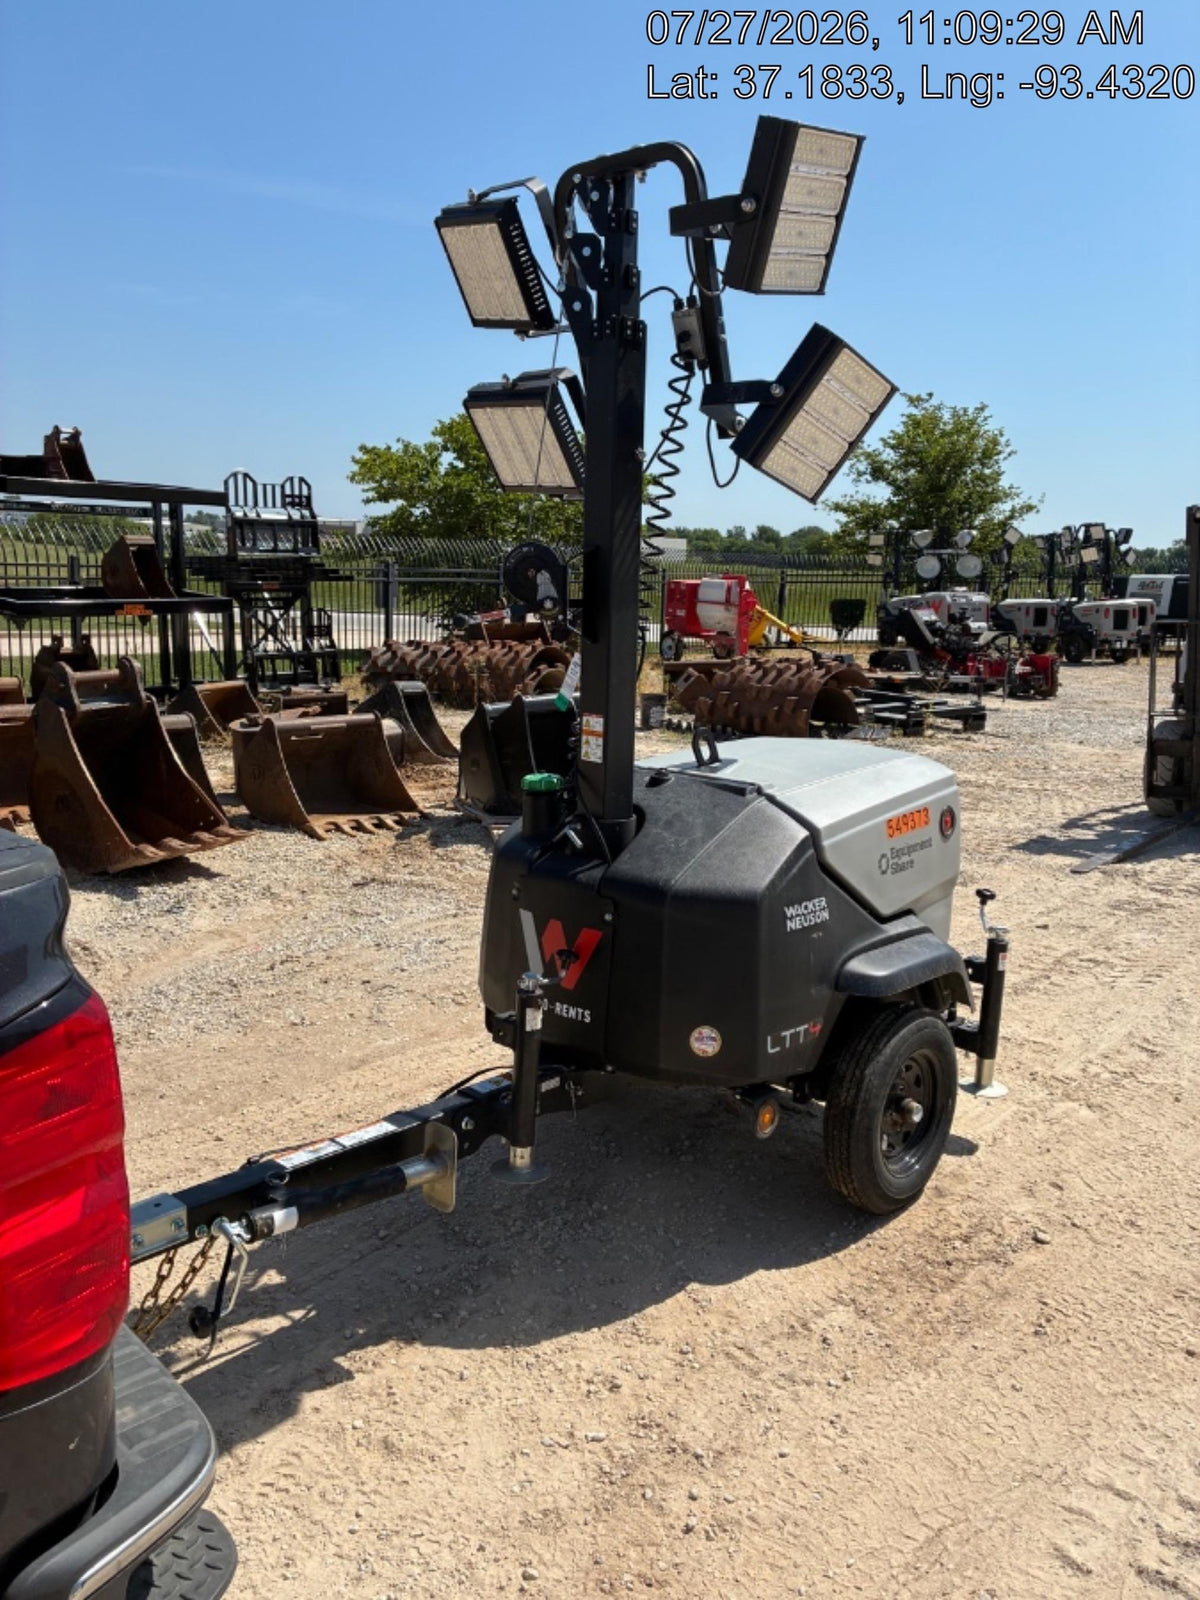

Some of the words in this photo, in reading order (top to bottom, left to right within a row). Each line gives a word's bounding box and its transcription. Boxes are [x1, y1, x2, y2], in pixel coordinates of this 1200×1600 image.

[886, 806, 930, 838] 549373
[783, 896, 828, 918] WACKER
[786, 908, 830, 932] NEUSON
[767, 1018, 823, 1054] LTT4
